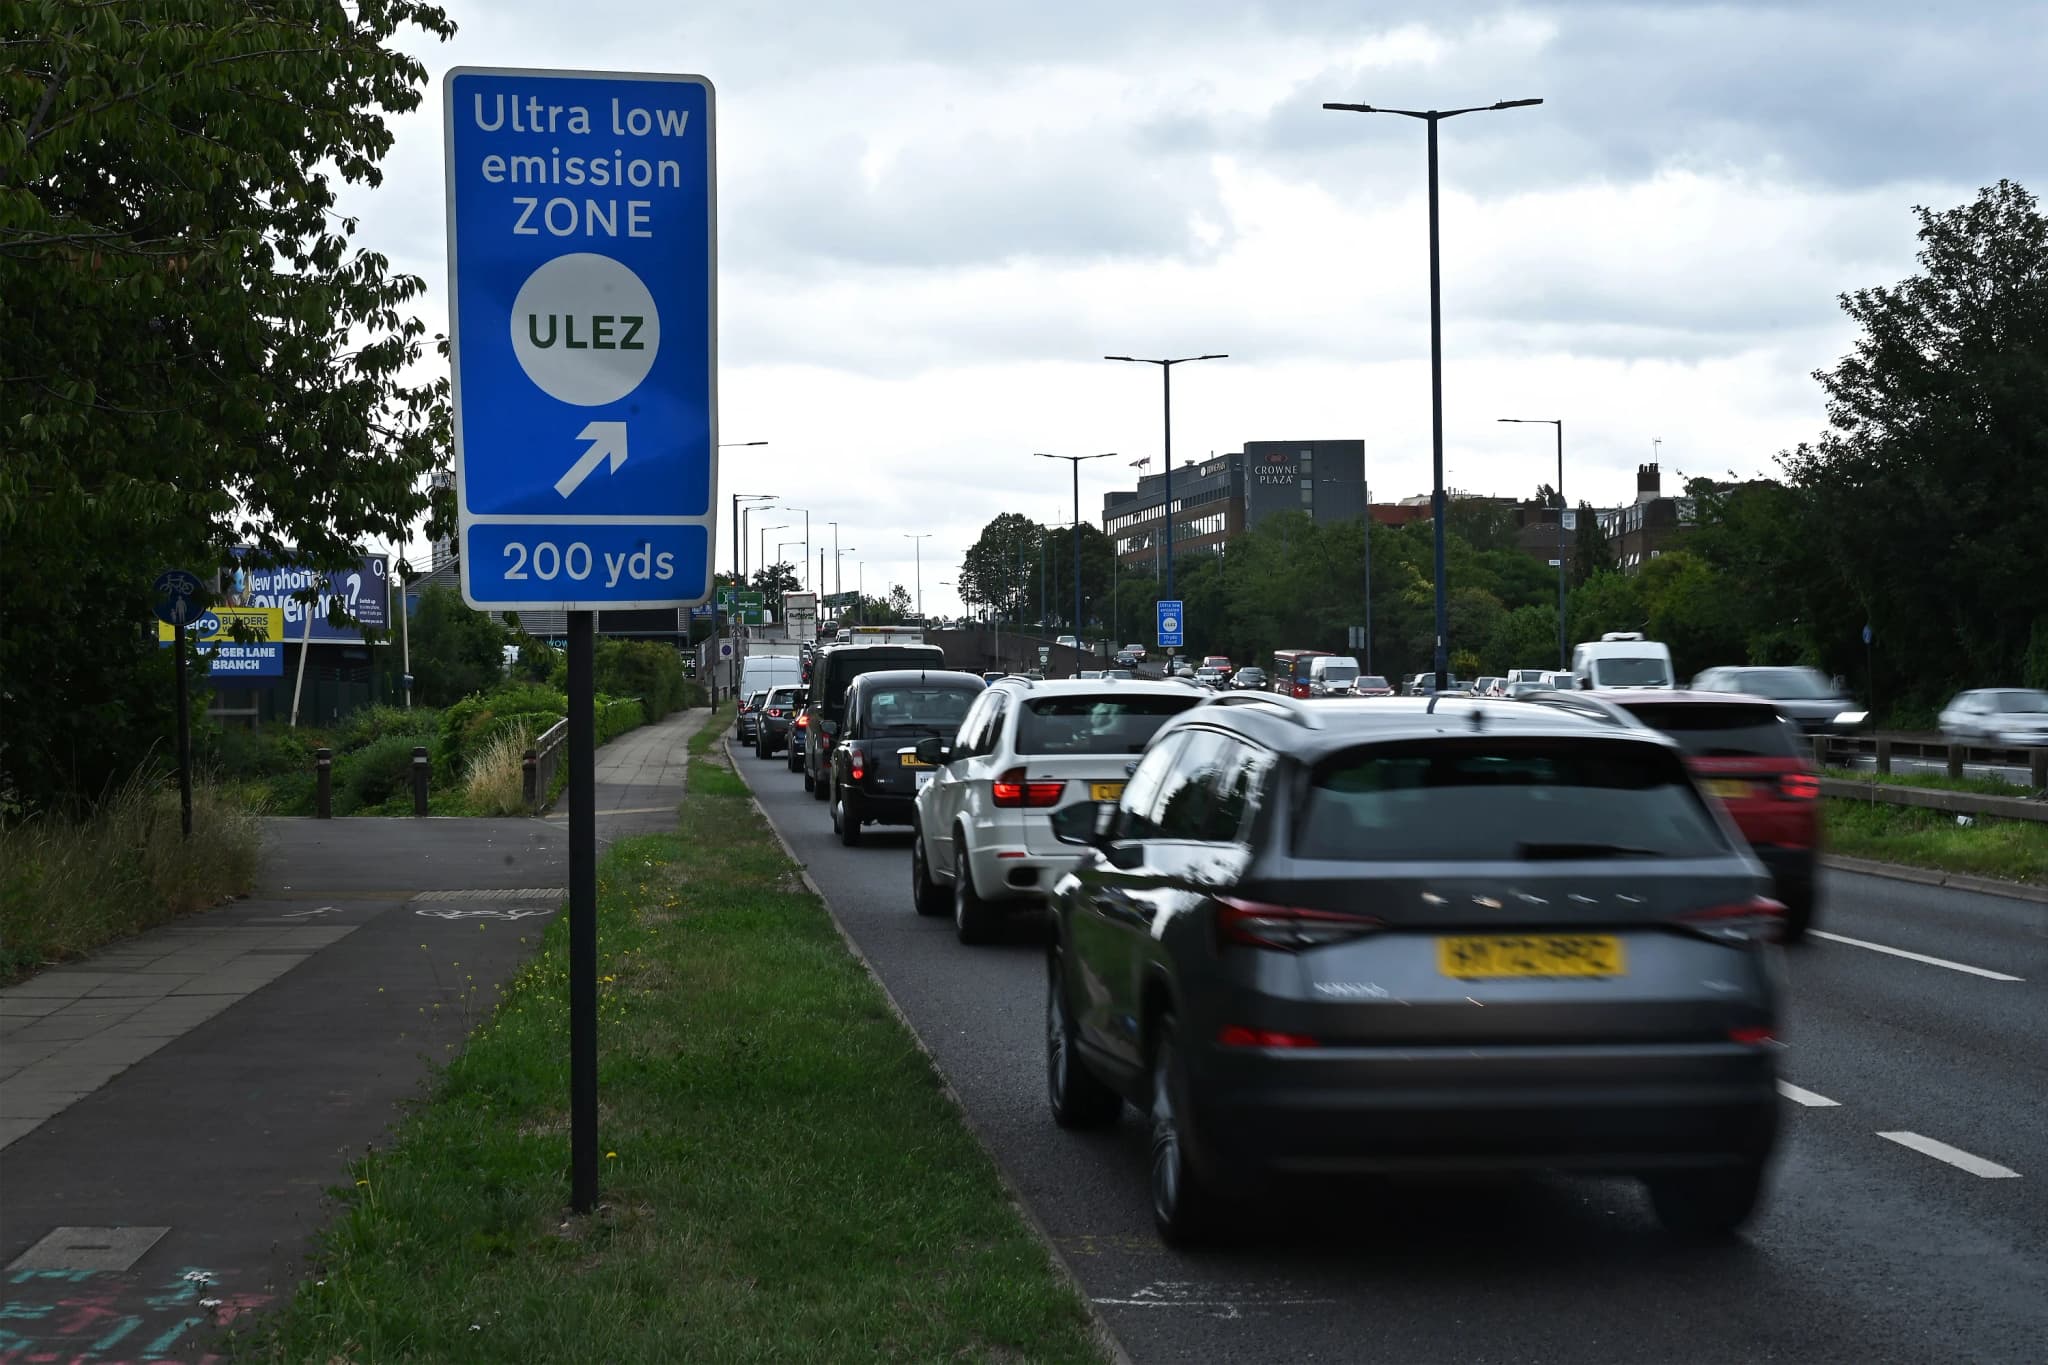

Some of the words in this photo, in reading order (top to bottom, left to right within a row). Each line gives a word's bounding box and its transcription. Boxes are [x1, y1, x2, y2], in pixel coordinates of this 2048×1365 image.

[474, 93, 591, 135] Ultra
[612, 98, 689, 137] low
[481, 147, 680, 188] emission
[513, 197, 653, 238] ZONE
[528, 314, 645, 350] ULEZ
[1254, 465, 1298, 475] CROWNE
[1259, 475, 1293, 485] PLAZA
[503, 541, 593, 581] 200
[604, 543, 674, 588] yds
[248, 575, 271, 592] New
[274, 568, 319, 595] phon
[184, 619, 218, 631] elco
[222, 616, 269, 625] BUDERS
[246, 647, 276, 658] LANE
[212, 659, 260, 670] BRANCH
